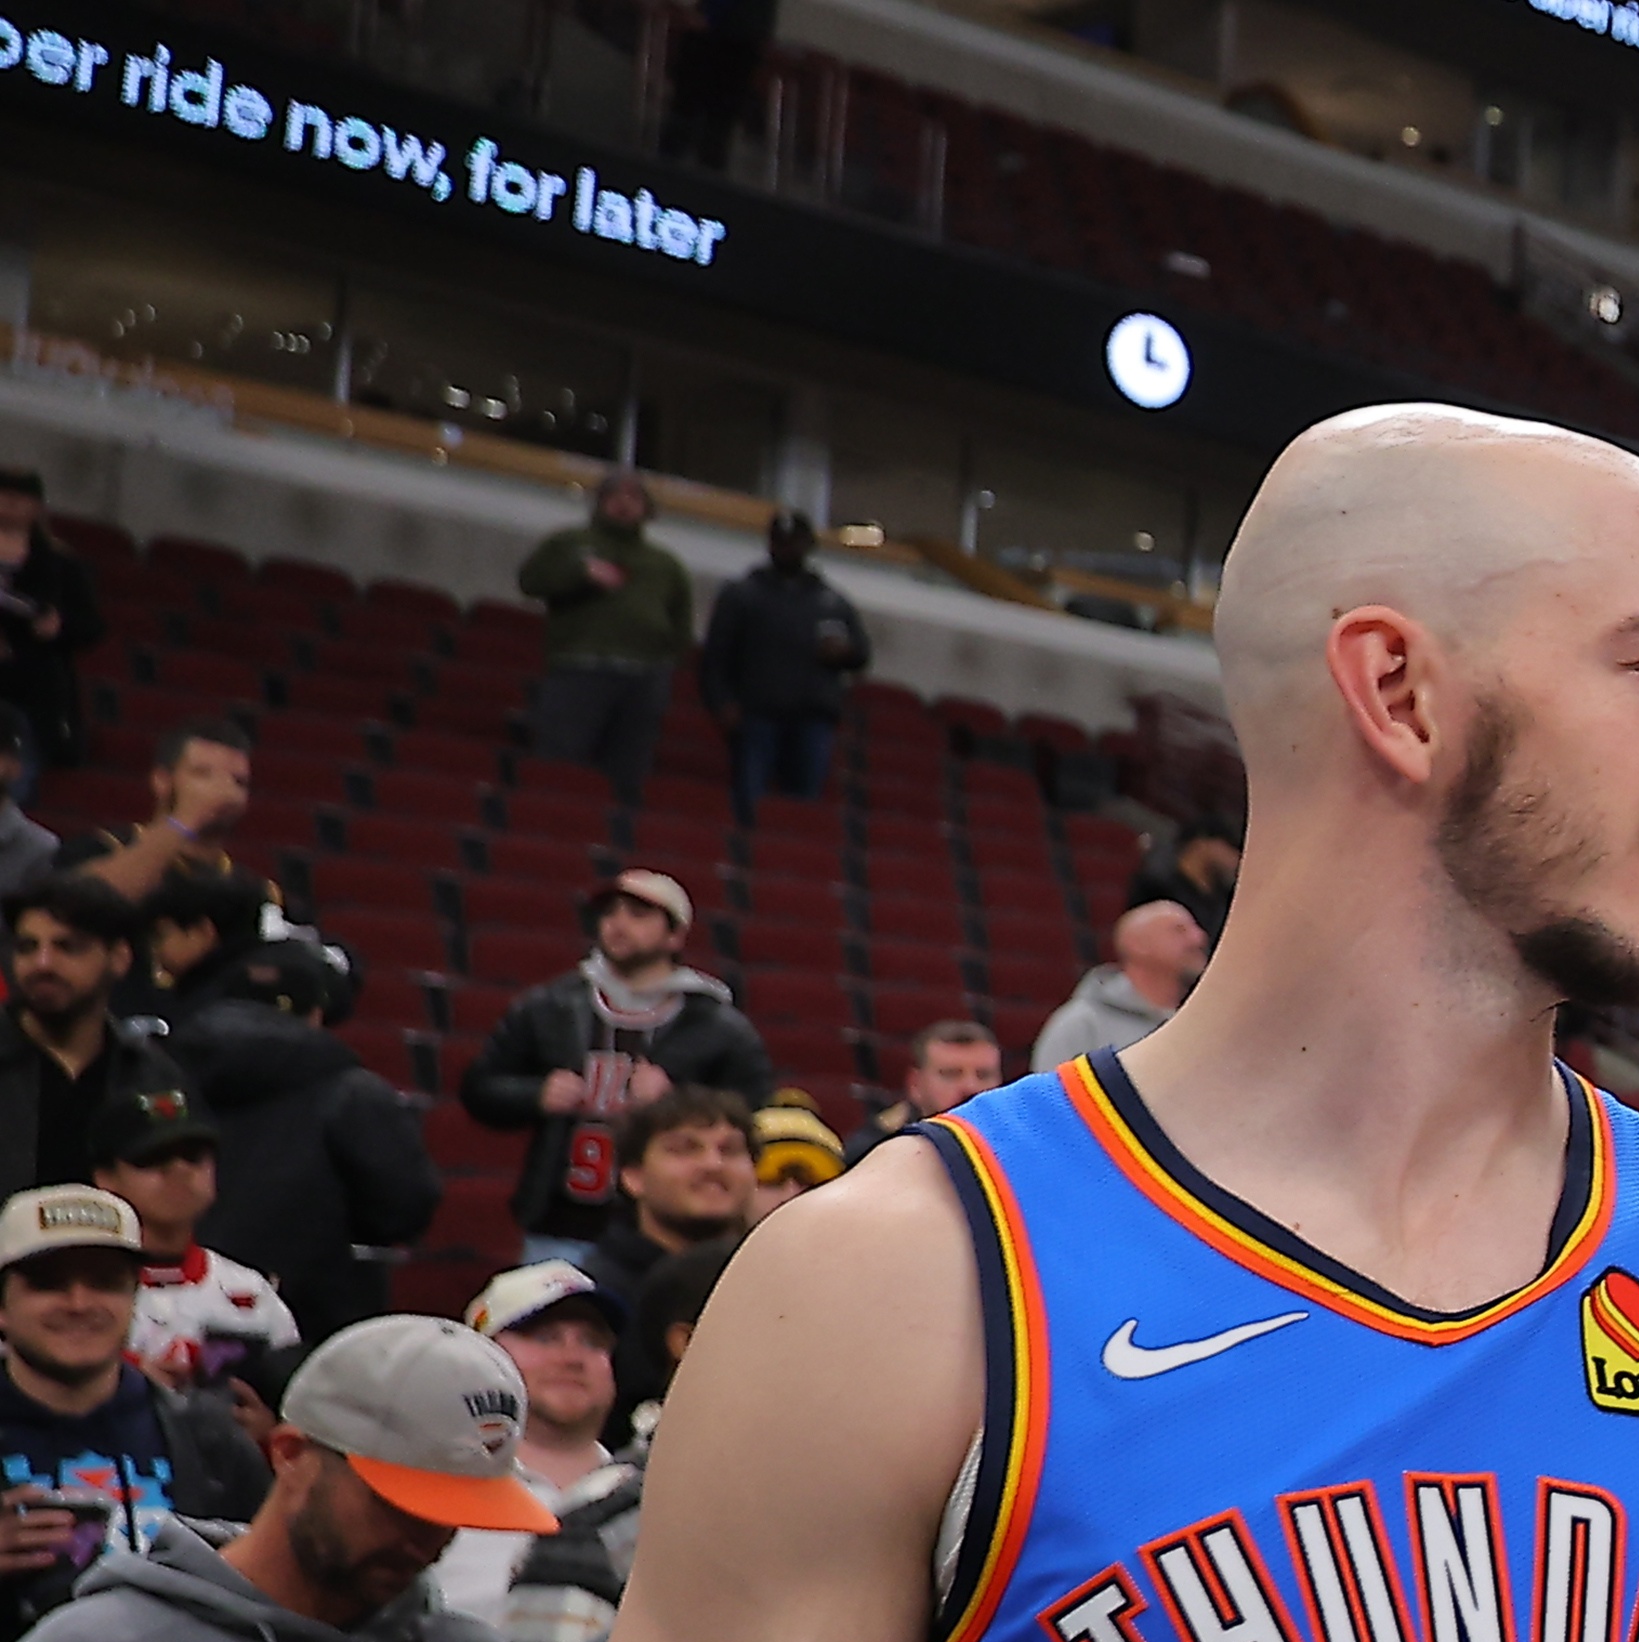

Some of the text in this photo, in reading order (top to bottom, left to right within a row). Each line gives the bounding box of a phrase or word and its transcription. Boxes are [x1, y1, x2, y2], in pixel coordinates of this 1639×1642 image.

[0, 17, 726, 265] er ride now, for later
